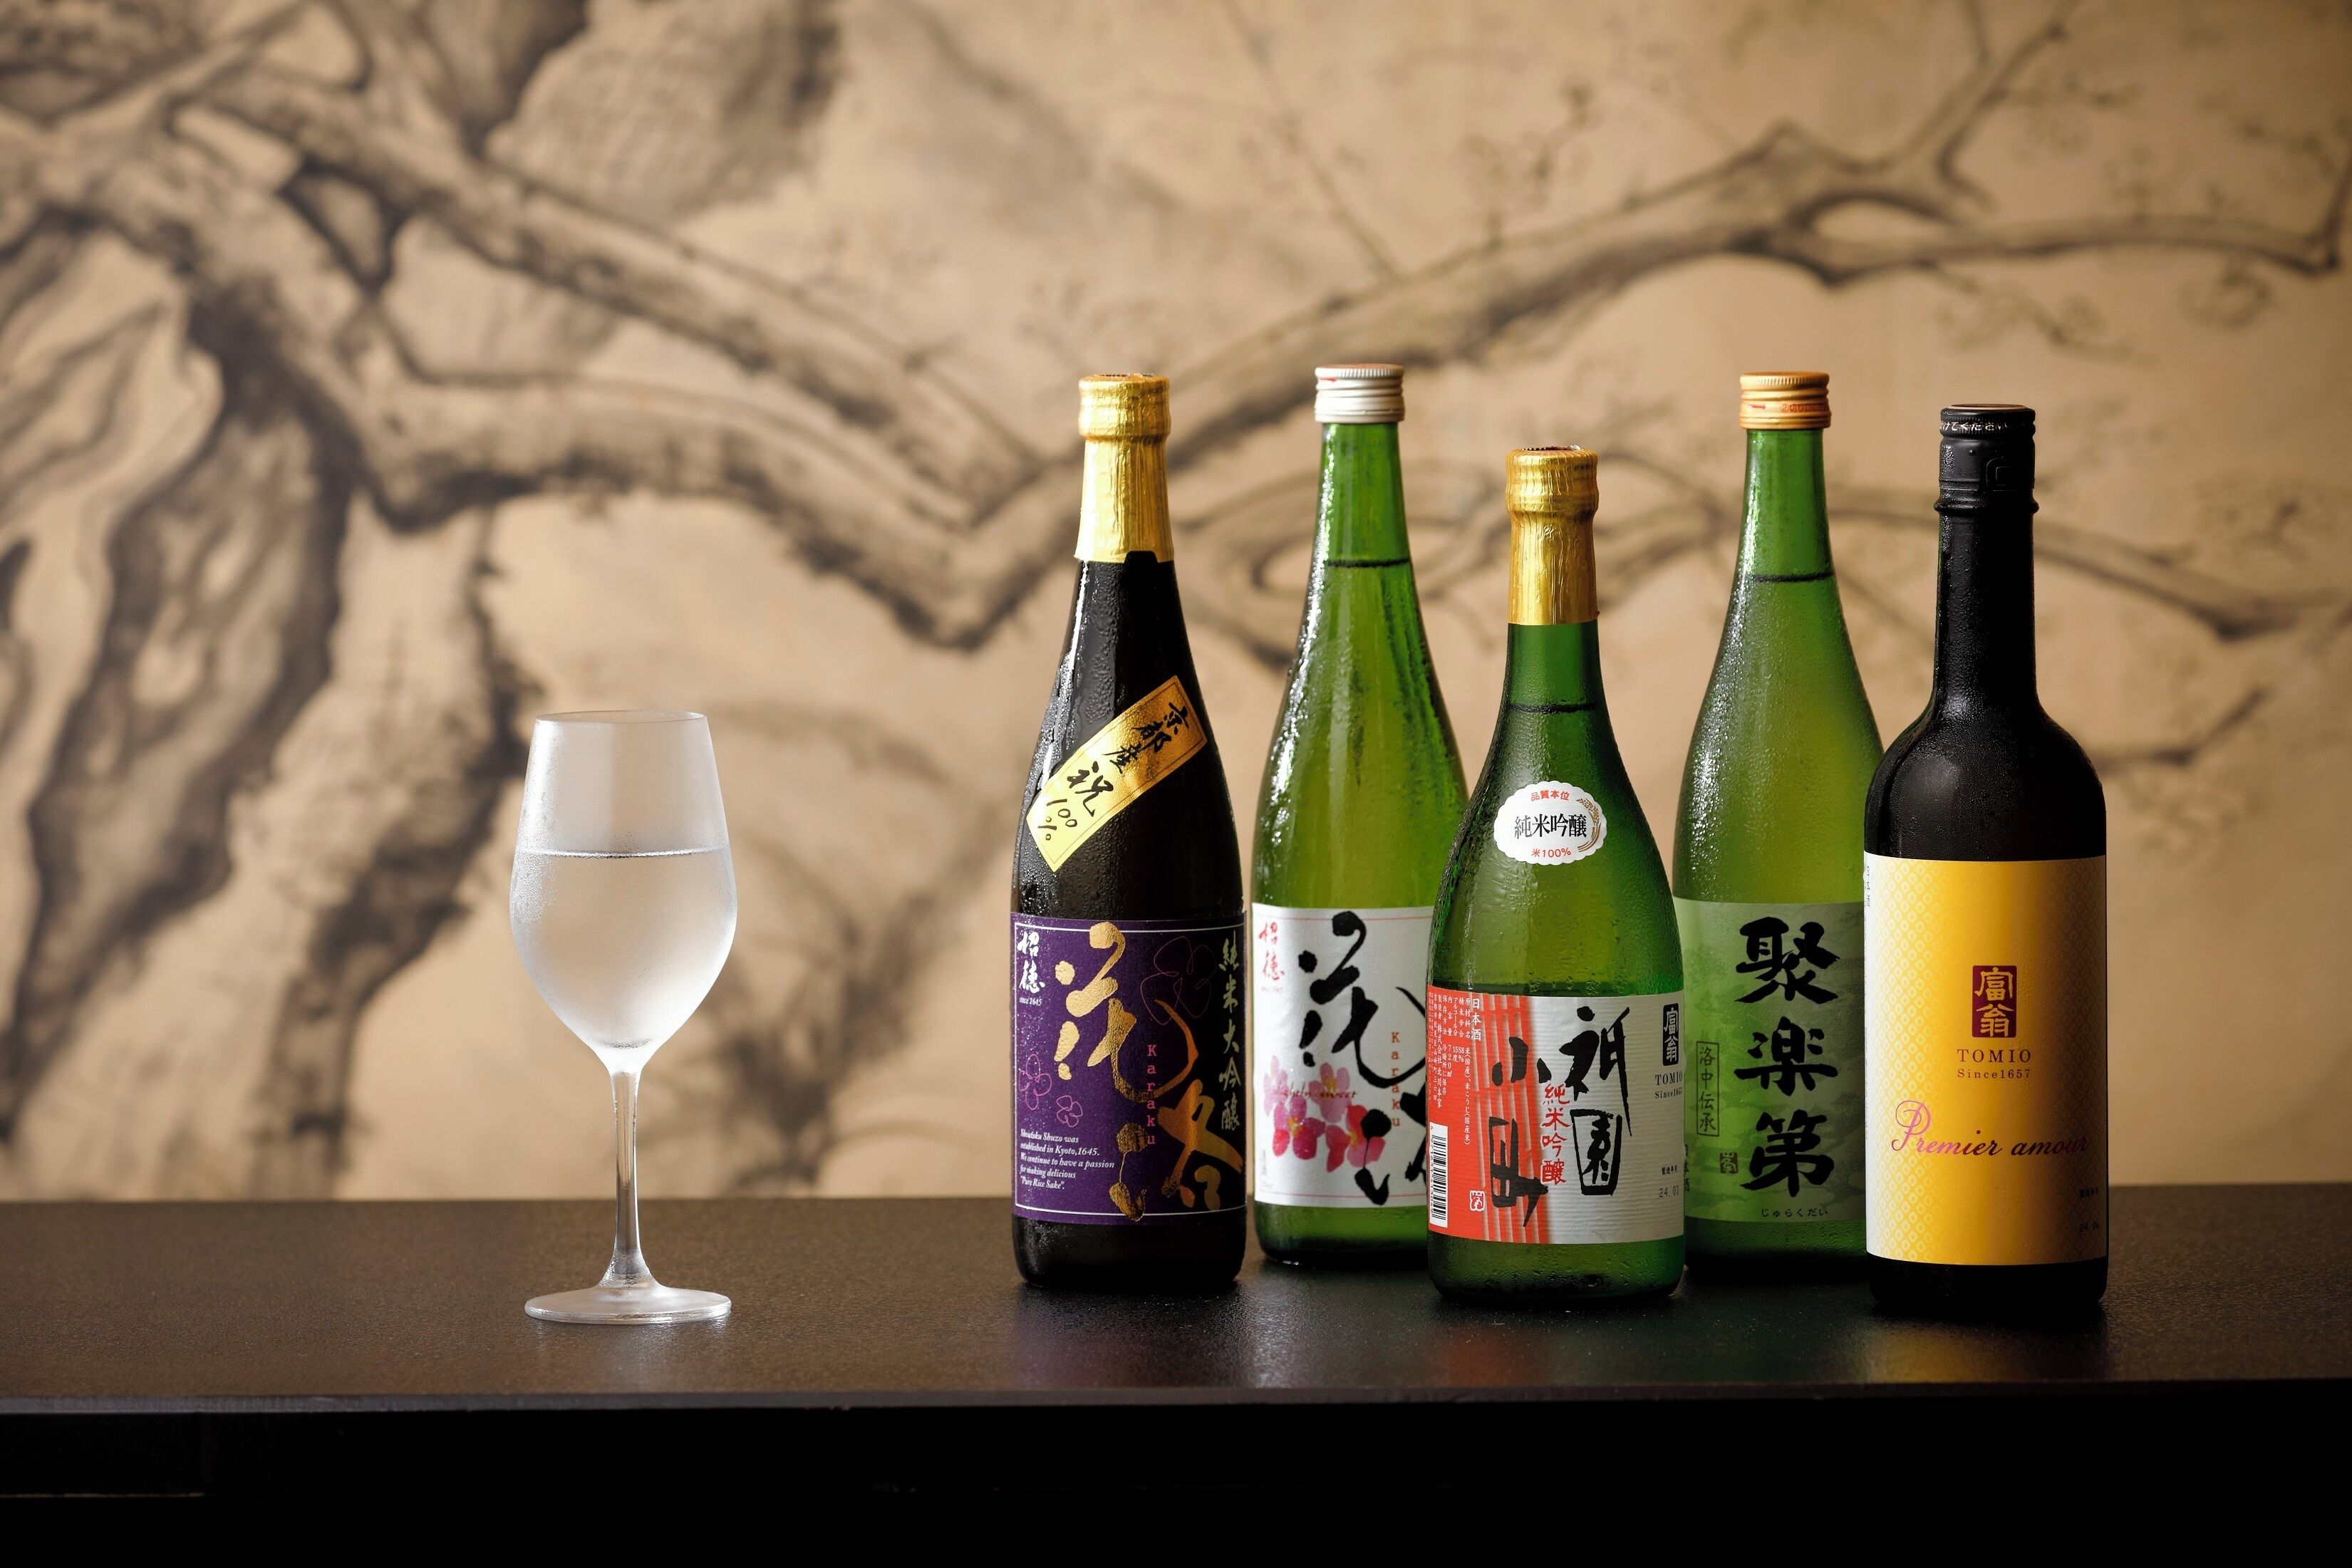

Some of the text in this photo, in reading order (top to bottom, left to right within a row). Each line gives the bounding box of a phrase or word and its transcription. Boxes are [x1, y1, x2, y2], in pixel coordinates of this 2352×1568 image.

[1530, 789, 1571, 801] 品質本位
[1514, 813, 1587, 839] 純米吟醸
[1531, 847, 1571, 858] 米100%
[1974, 966, 2015, 1037] 富翁
[1471, 998, 1482, 1042] 日本酒
[1218, 930, 1242, 1131] 純米大吟醸
[1664, 1007, 1679, 1064] 富翁
[1734, 916, 1840, 1198] 聚楽第
[1957, 1048, 2032, 1063] TOMIO
[1654, 1074, 1683, 1086] TOMIO
[1957, 1068, 2031, 1079] Since1657
[1146, 1044, 1157, 1146] Karaku
[1698, 1045, 1718, 1136] 洛中伝承
[1020, 1128, 1042, 1140] Shoutoku
[1042, 1132, 1063, 1143] Shuzo
[1541, 1083, 1570, 1186] 純米吟醸
[1891, 1099, 2089, 1157] Premier amour
[1020, 1142, 1046, 1153] established
[1020, 1152, 1027, 1161] We
[1027, 1155, 1050, 1165] continue
[1060, 1158, 1077, 1167] have
[1084, 1160, 1115, 1170] passion
[1027, 1166, 1047, 1179] making
[1047, 1169, 1076, 1179] delicious
[1032, 1179, 1045, 1188] Rice
[1659, 1185, 1679, 1198] 24.03
[1761, 1207, 1829, 1218] じゅらくだい
